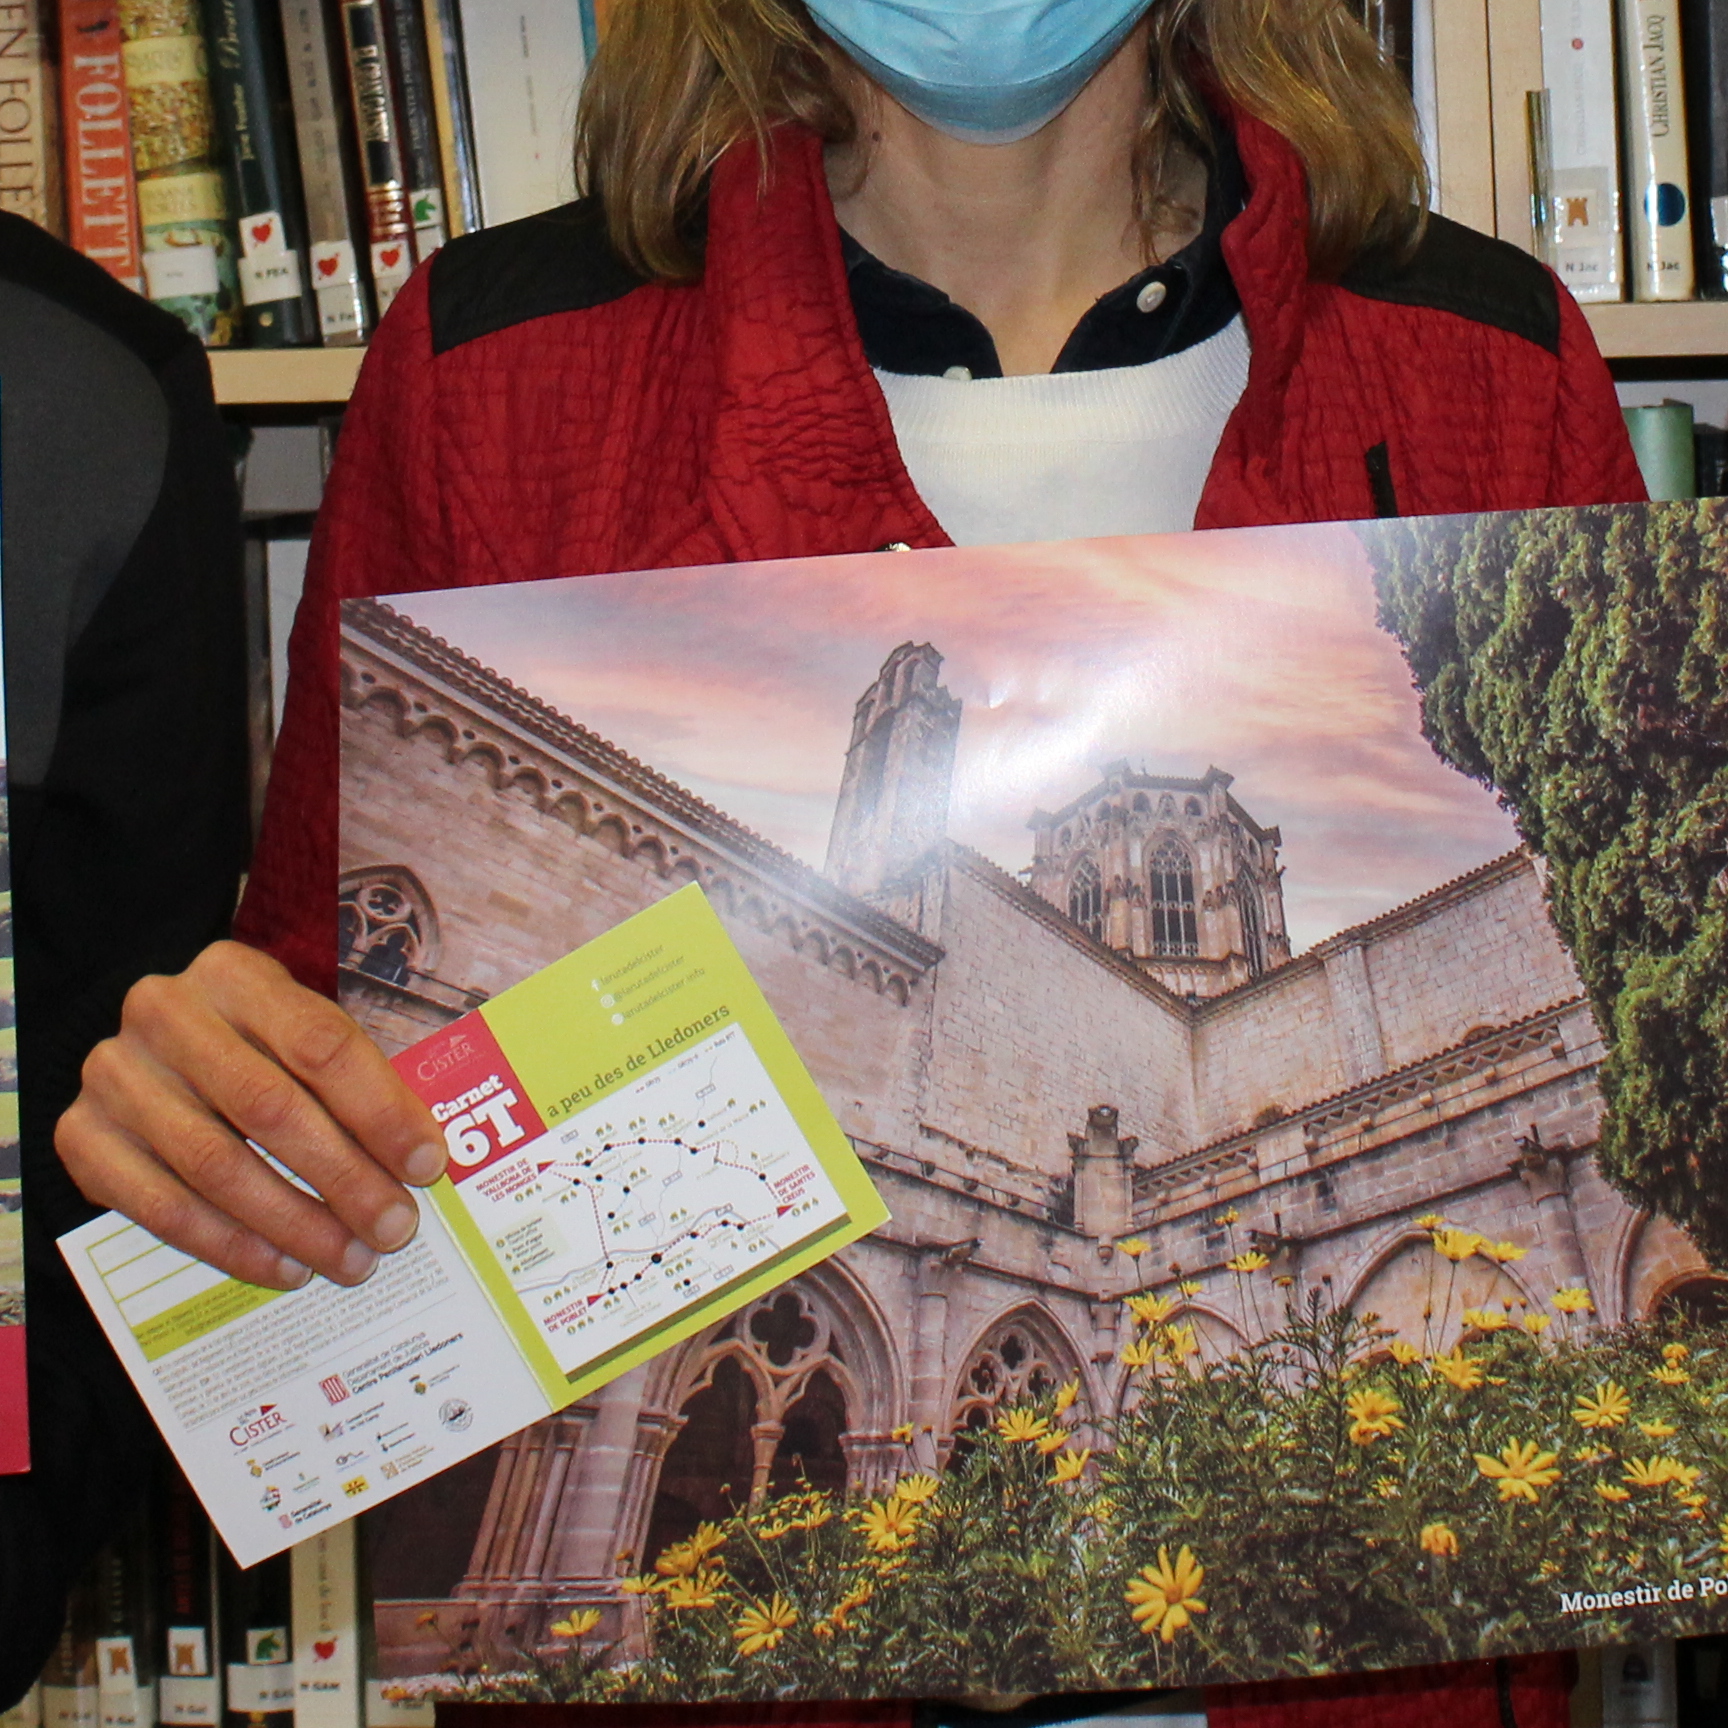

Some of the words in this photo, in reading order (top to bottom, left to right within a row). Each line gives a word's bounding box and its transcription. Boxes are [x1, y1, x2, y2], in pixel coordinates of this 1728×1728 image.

[1642, 15, 1670, 53] JACQ
[1648, 56, 1671, 141] CHRISTIAN
[74, 52, 133, 270] FOLLETT
[417, 1042, 475, 1082] CISTER
[547, 1103, 561, 1118] a
[561, 1084, 593, 1115] peu
[595, 1066, 625, 1091] des
[624, 1054, 647, 1080] de
[647, 1003, 730, 1060] Lledoners
[430, 1074, 504, 1124] Carnet
[442, 1089, 526, 1168] 6T
[228, 1414, 286, 1449] CISTER
[1561, 1585, 1662, 1614] Monestir
[1668, 1582, 1694, 1601] de
